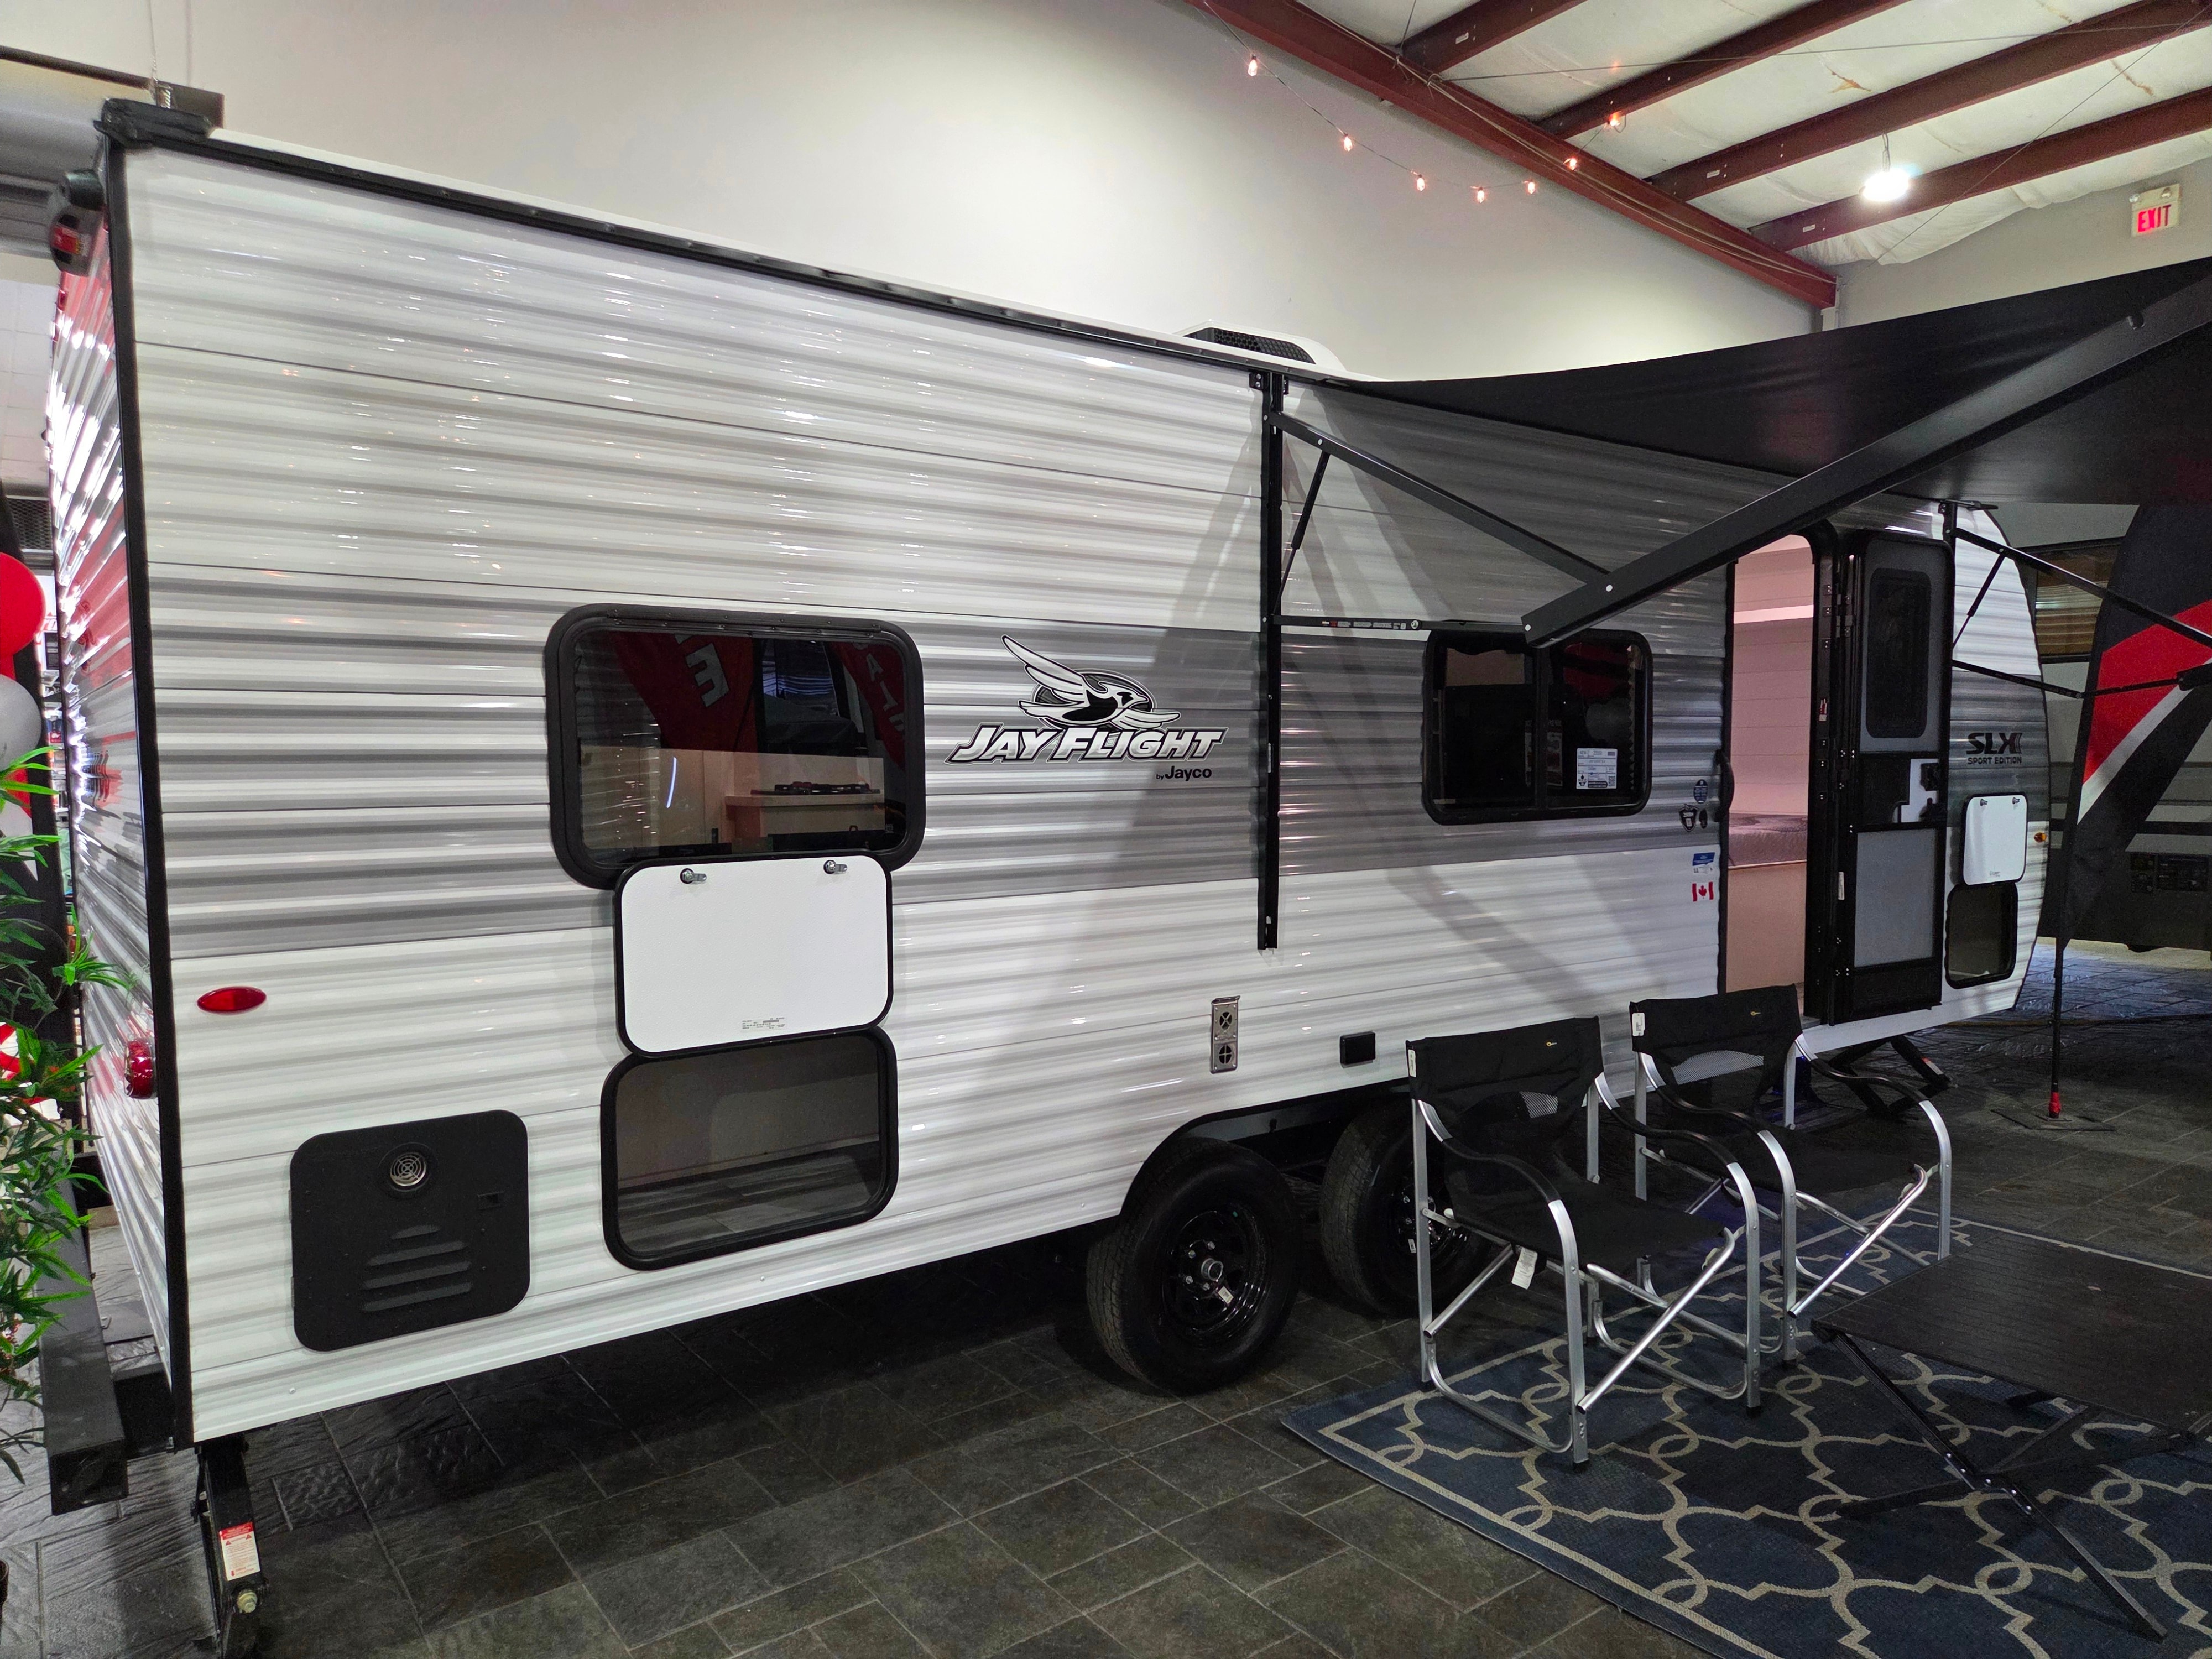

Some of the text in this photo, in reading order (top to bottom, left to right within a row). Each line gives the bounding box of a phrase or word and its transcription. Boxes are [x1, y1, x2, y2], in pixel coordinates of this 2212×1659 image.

[2137, 204, 2171, 232] EXIT
[946, 724, 1227, 763] JAY FLIGHT
[1966, 733, 2022, 755] SLX
[1165, 765, 1212, 781] Jayco
